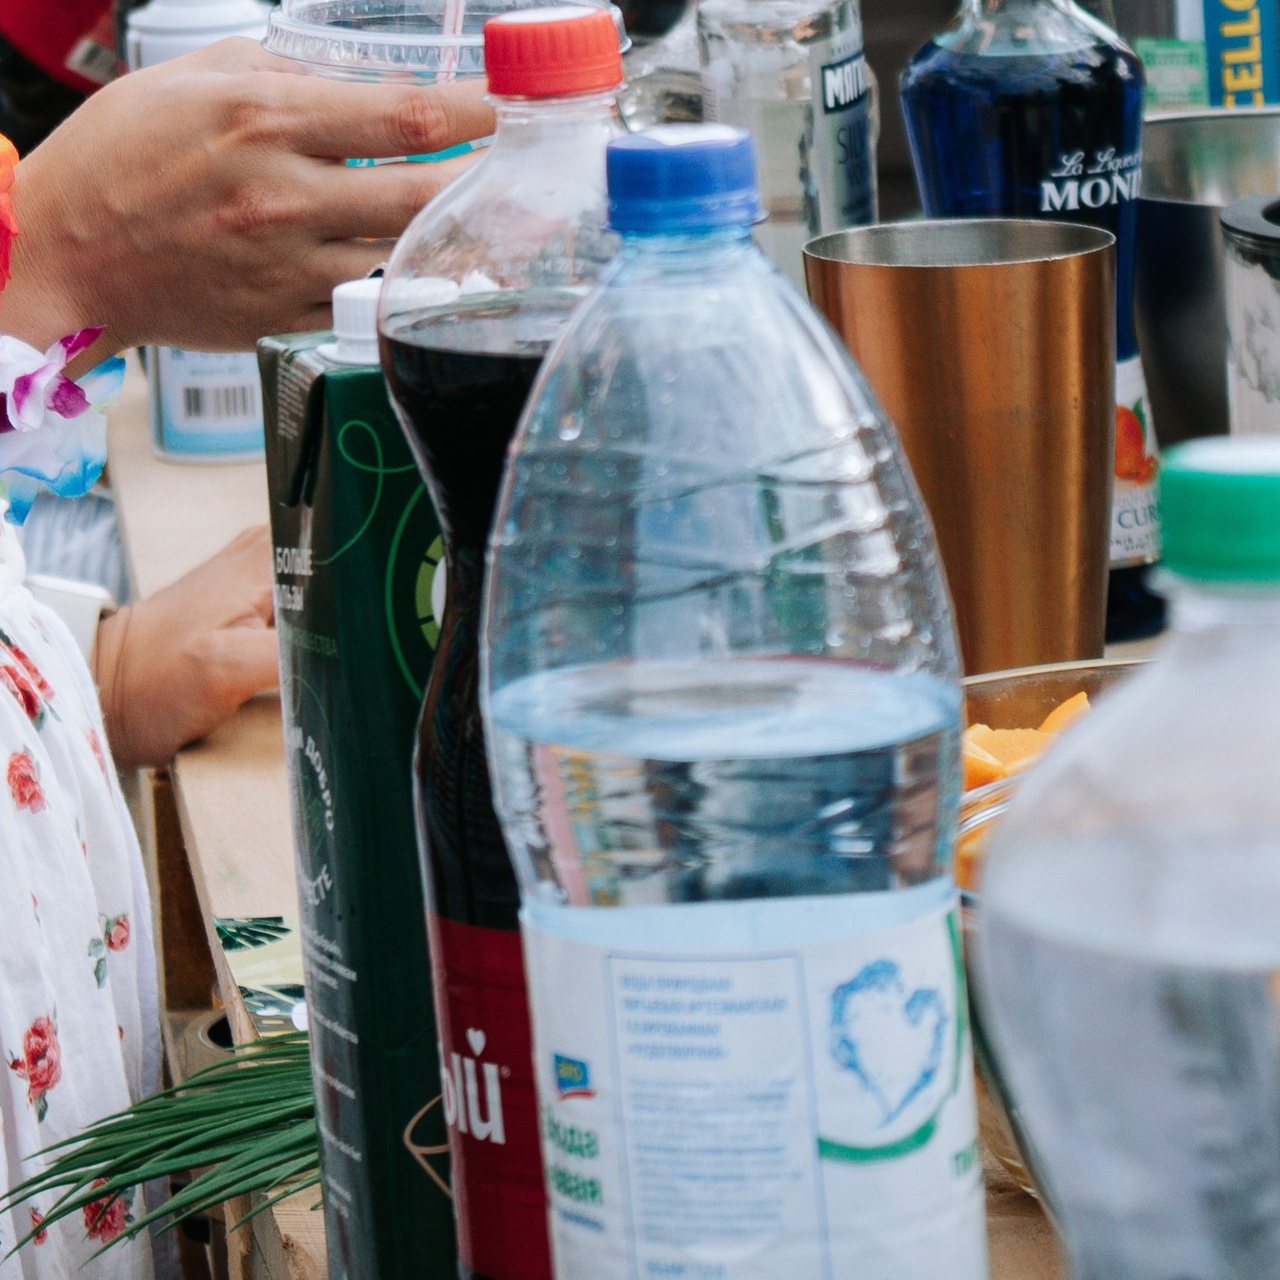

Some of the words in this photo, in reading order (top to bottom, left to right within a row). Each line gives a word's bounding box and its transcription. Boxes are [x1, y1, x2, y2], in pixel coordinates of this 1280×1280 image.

[1051, 151, 1085, 177] La
[1041, 171, 1140, 212] MONI
[276, 547, 313, 575] БОЛЬШЕ
[305, 735, 334, 831] ДОБРО
